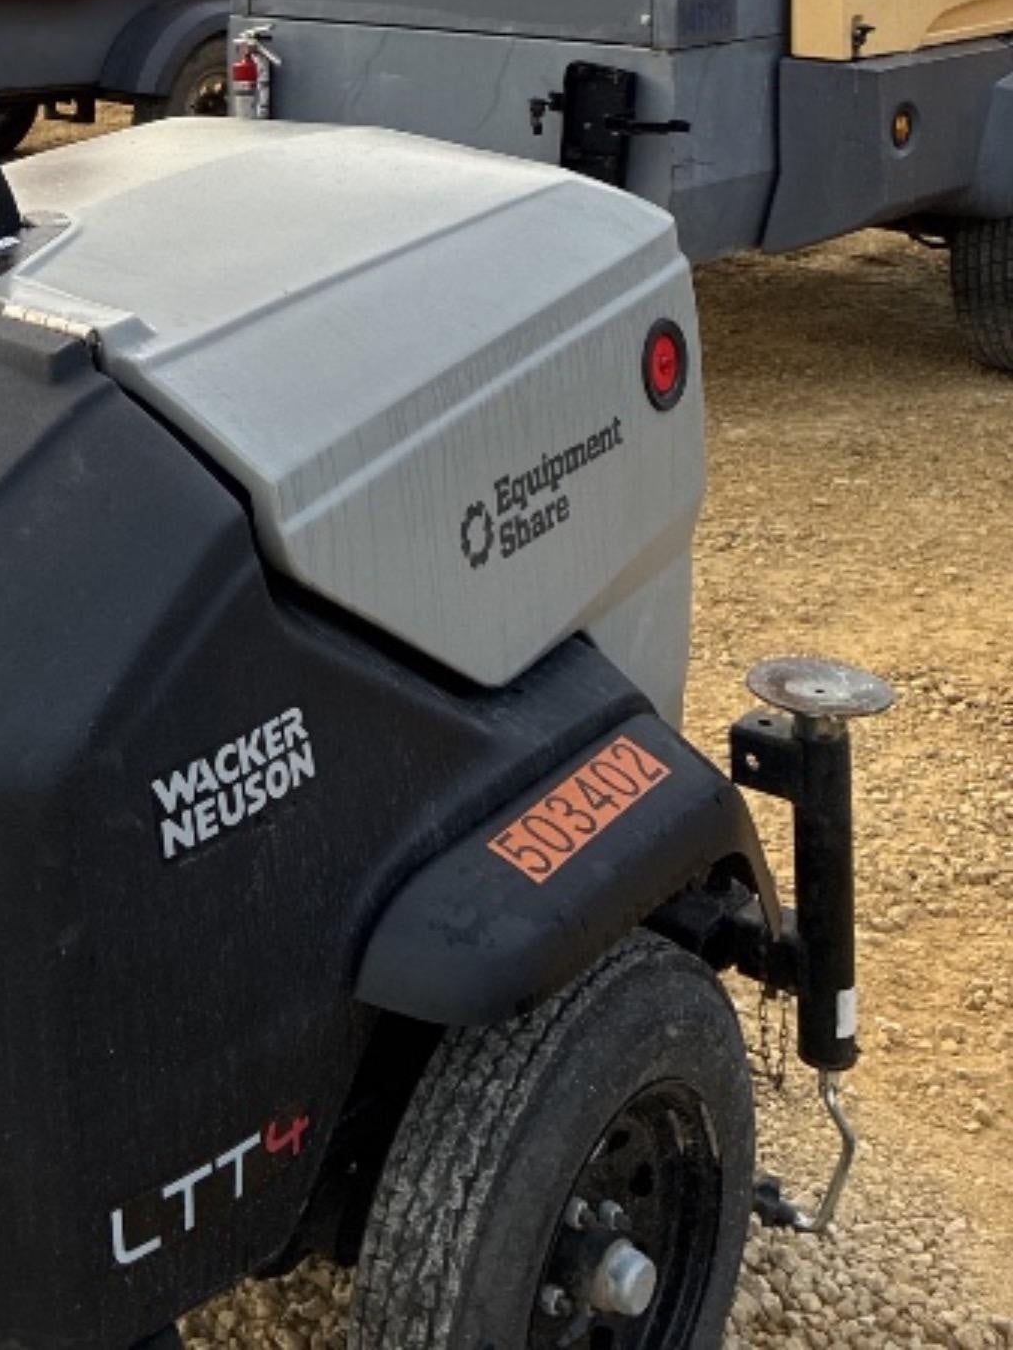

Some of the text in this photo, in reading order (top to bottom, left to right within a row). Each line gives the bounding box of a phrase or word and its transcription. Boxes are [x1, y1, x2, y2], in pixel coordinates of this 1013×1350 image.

[494, 415, 624, 517] Equipment
[499, 494, 570, 559] Share
[151, 707, 309, 814] WACKER
[160, 740, 316, 860] NEUSON
[496, 743, 663, 874] 503402
